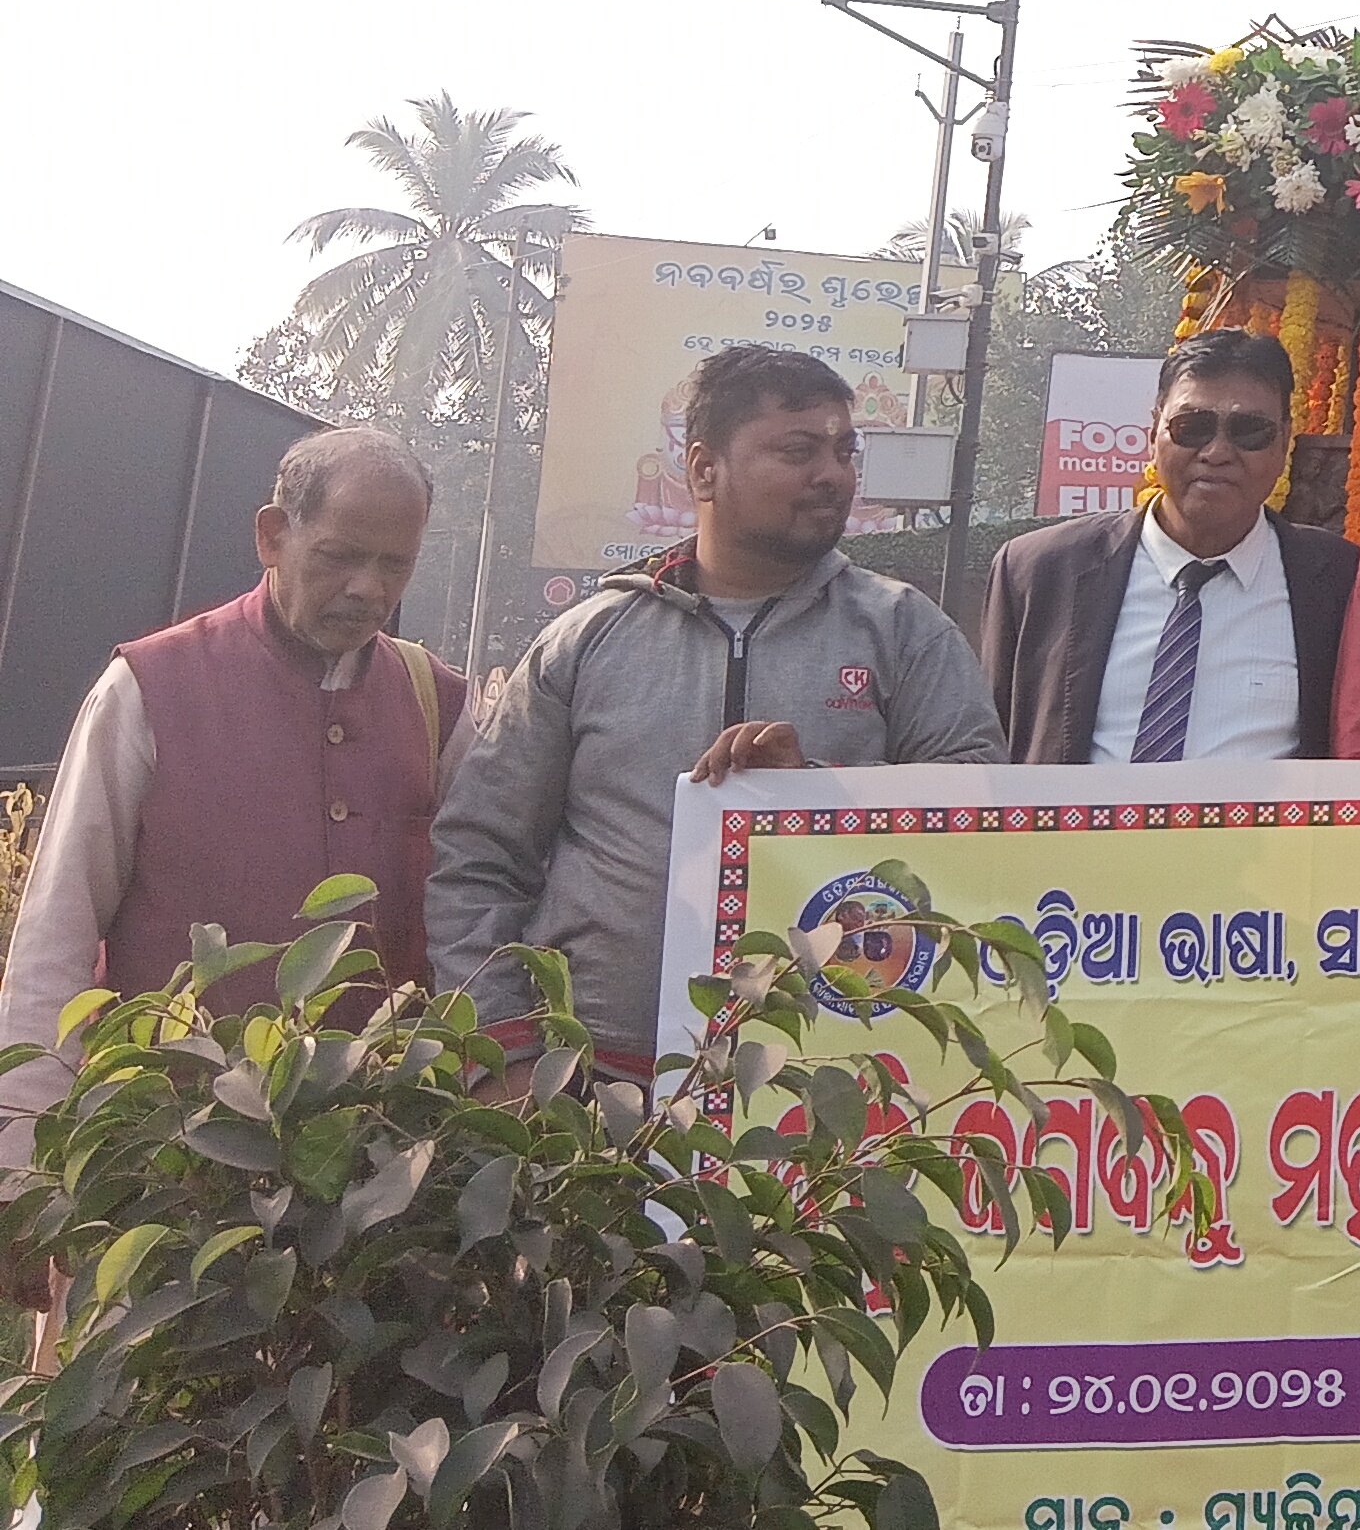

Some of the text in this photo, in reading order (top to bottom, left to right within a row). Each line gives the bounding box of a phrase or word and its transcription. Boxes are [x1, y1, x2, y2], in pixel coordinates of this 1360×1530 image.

[766, 311, 832, 332] ୨୦୨୫
[1060, 419, 1155, 455] FOO
[1059, 456, 1106, 472] mat
[1159, 910, 1296, 982] ଭାଷା,
[1047, 1368, 1347, 1415] ୨୪.୦୧.୨୦୨୫
